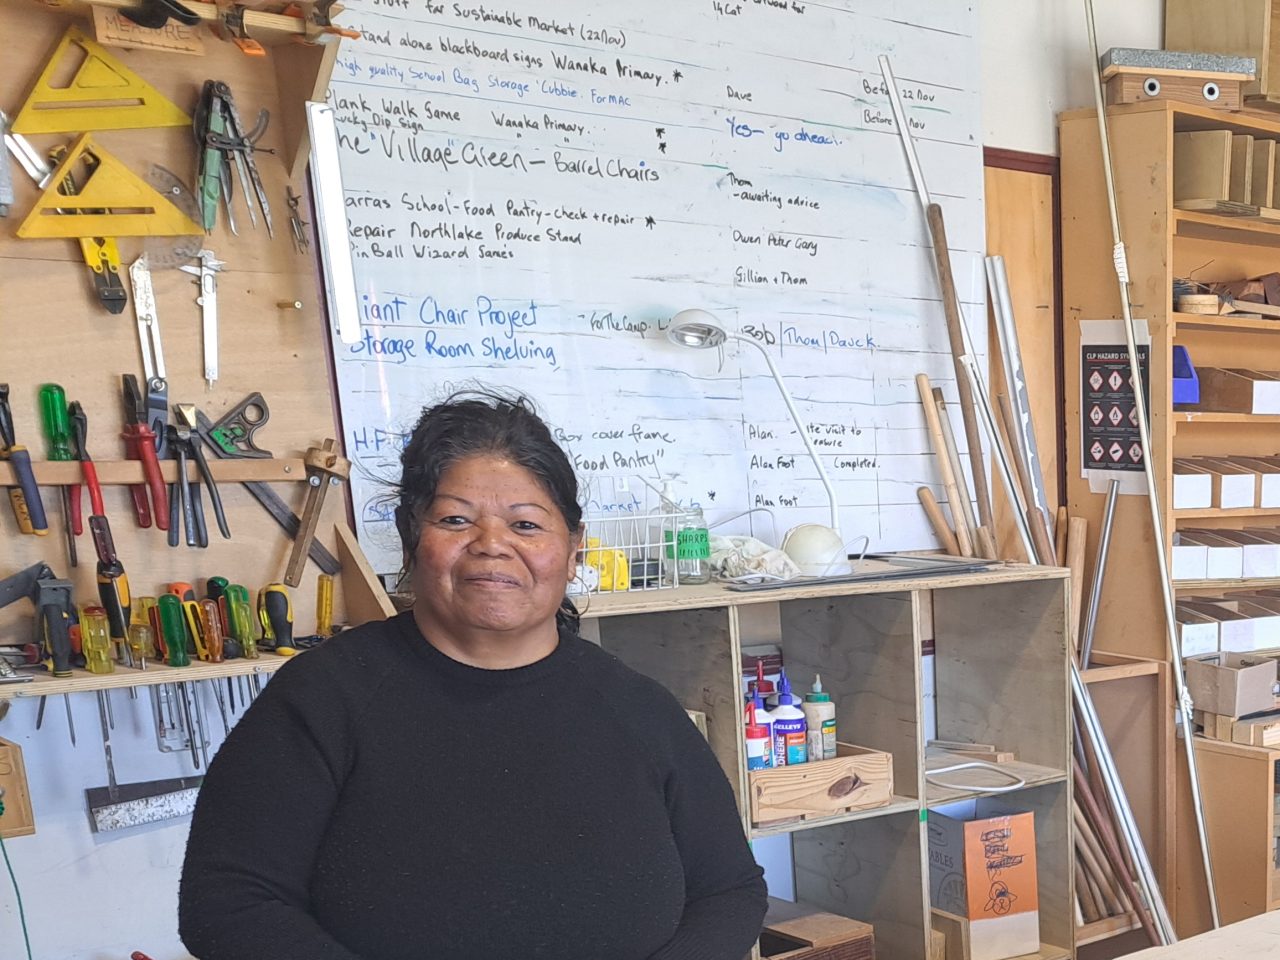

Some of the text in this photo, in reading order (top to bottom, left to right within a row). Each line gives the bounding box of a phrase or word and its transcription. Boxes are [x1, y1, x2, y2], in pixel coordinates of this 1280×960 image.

[528, 16, 575, 36] Market
[347, 25, 391, 46] tand
[399, 32, 433, 51] alone
[439, 36, 509, 62] blackboard
[513, 50, 544, 69] signs
[551, 51, 607, 76] Wanaka
[453, 67, 480, 93] Bag
[488, 75, 529, 97] Storage
[382, 98, 418, 118] Walk
[372, 113, 392, 129] Dip
[491, 111, 539, 130] Wanaka
[337, 128, 370, 155] he
[344, 196, 392, 210] arras
[787, 195, 821, 210] advice
[410, 221, 484, 241] Northlake
[494, 222, 542, 243] Produce
[546, 227, 582, 245] Stand
[732, 229, 762, 245] Owen
[412, 245, 470, 259] Wizard
[780, 271, 809, 285] Thom
[361, 293, 539, 340] iant Chair Project
[424, 329, 475, 359] Room
[481, 335, 557, 367] Shelving
[1086, 352, 1097, 360] CLP
[1097, 352, 1120, 360] HAZARD
